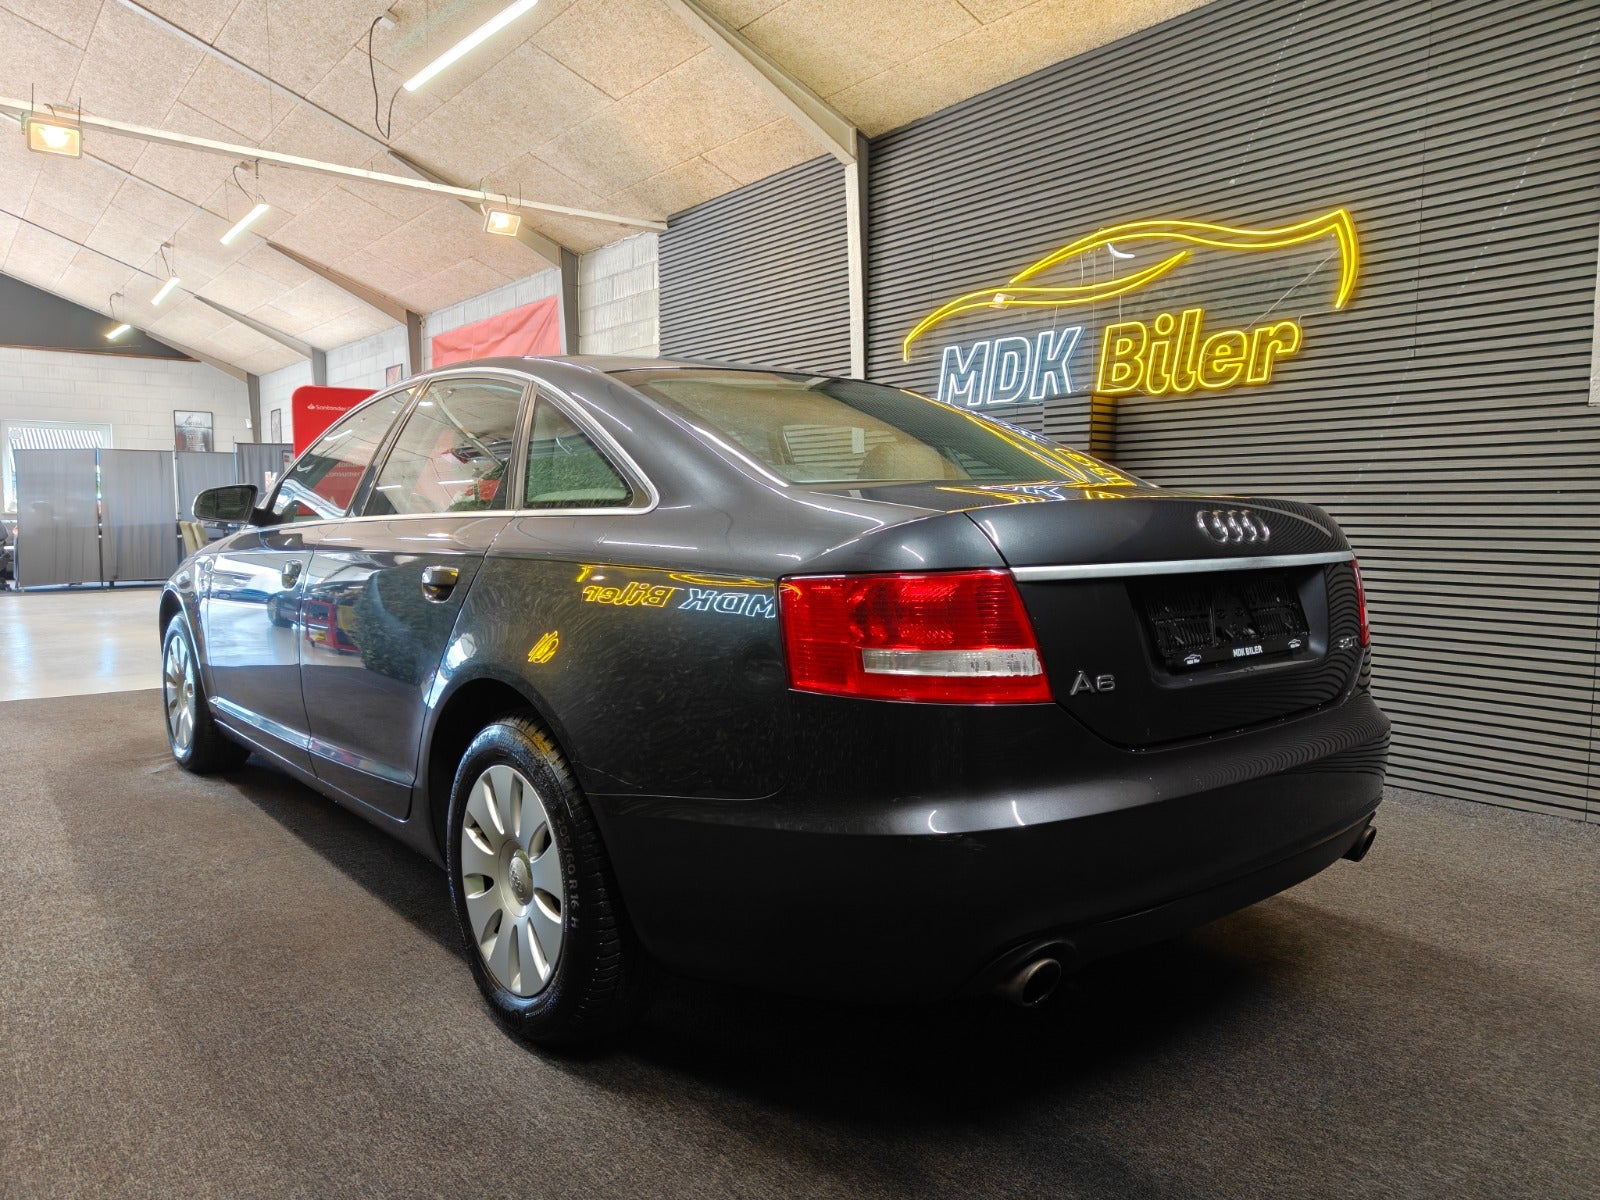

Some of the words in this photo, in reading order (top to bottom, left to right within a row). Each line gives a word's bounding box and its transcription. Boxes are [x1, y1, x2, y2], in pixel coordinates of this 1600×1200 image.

[936, 325, 1082, 407] MDK
[1096, 308, 1302, 396] Biler
[1070, 670, 1116, 695] A6
